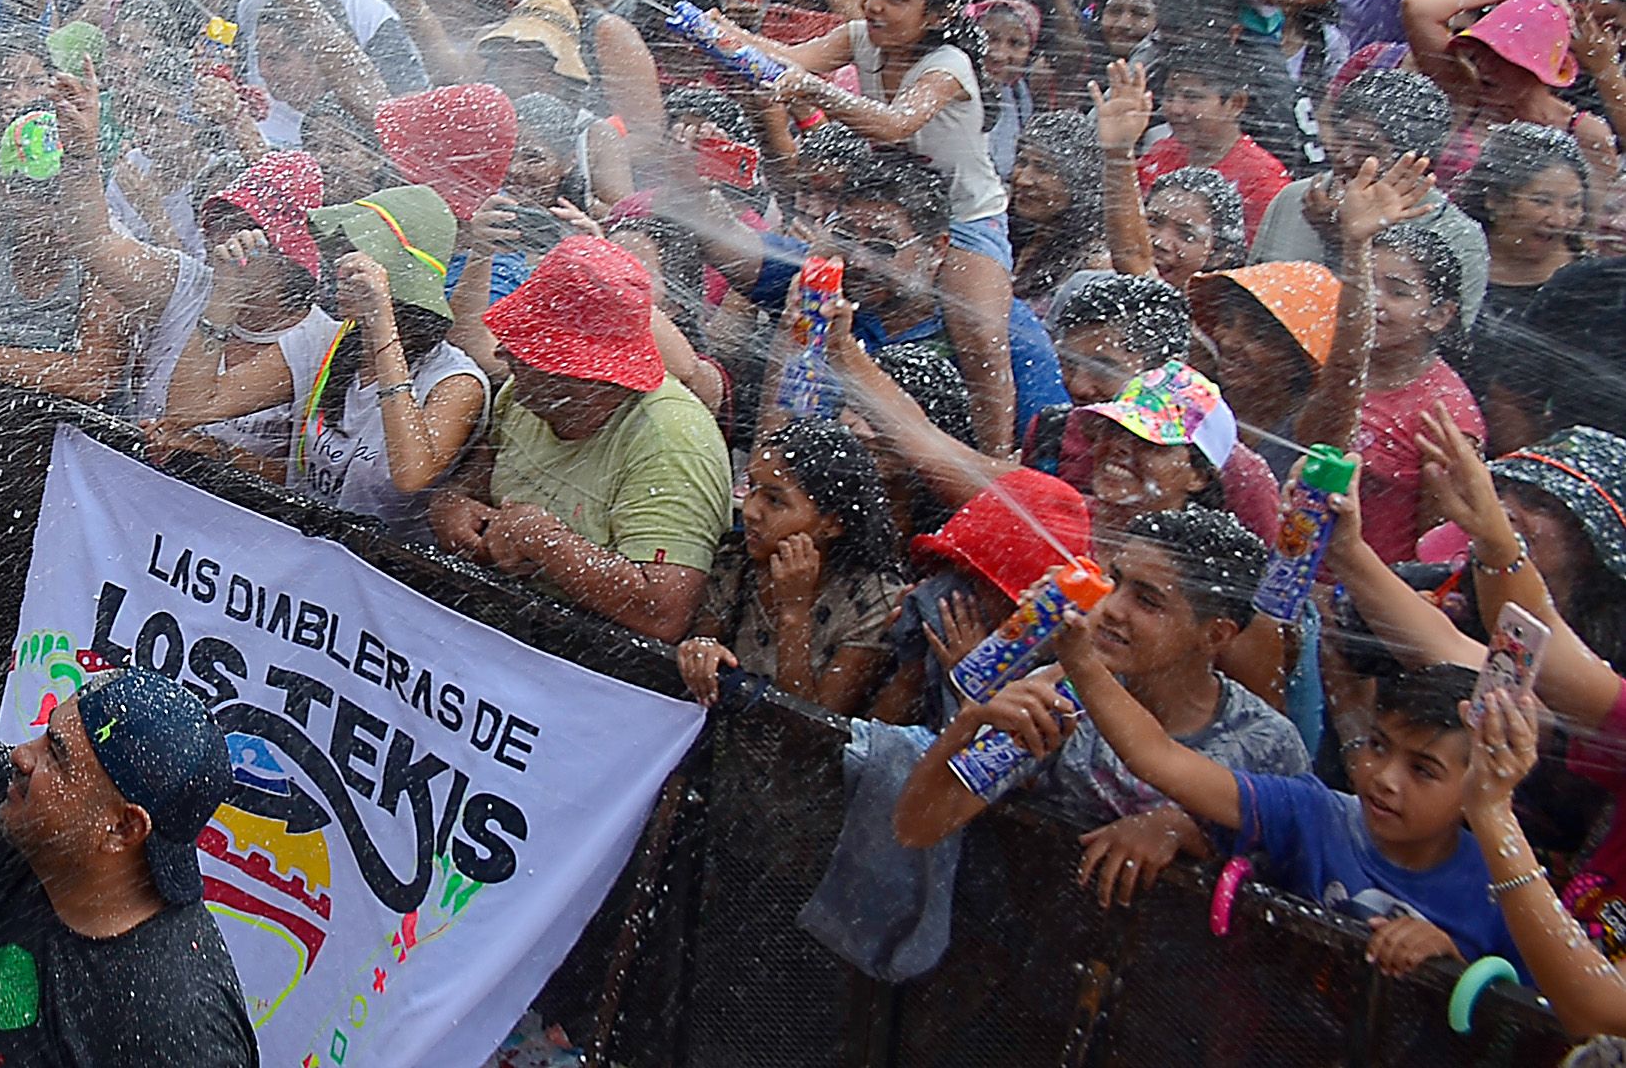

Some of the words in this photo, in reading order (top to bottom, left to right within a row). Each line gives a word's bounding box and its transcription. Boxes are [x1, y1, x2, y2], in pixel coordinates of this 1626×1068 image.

[90, 581, 248, 707] LOS
[265, 663, 528, 894] TEKIS
[147, 533, 220, 603] LAS
[224, 574, 465, 733] DIABLERAS
[470, 698, 540, 772] DE
